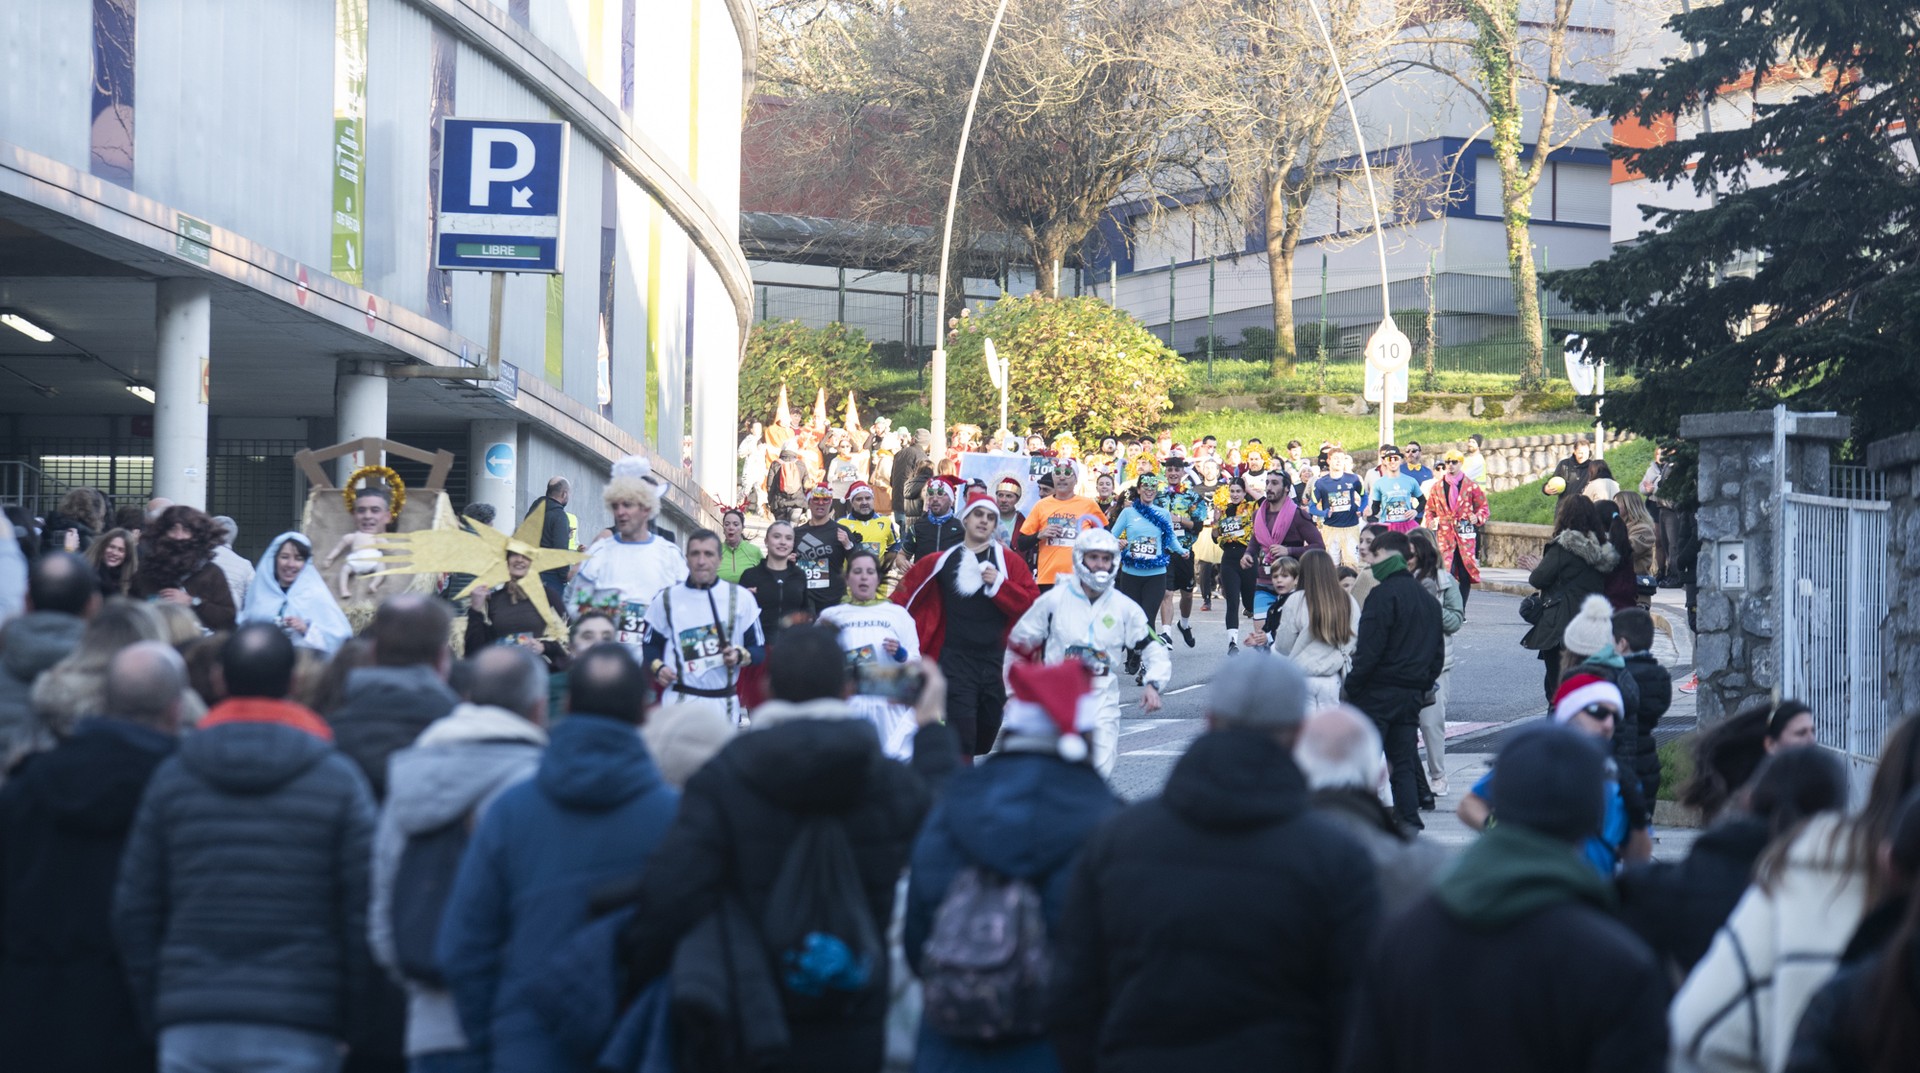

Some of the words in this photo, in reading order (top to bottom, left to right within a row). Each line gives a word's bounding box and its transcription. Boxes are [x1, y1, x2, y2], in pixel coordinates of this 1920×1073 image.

[469, 127, 536, 207] P
[482, 245, 515, 256] LIBRE
[1379, 343, 1400, 359] 10
[1222, 522, 1241, 533] 284
[1133, 543, 1155, 554] 385
